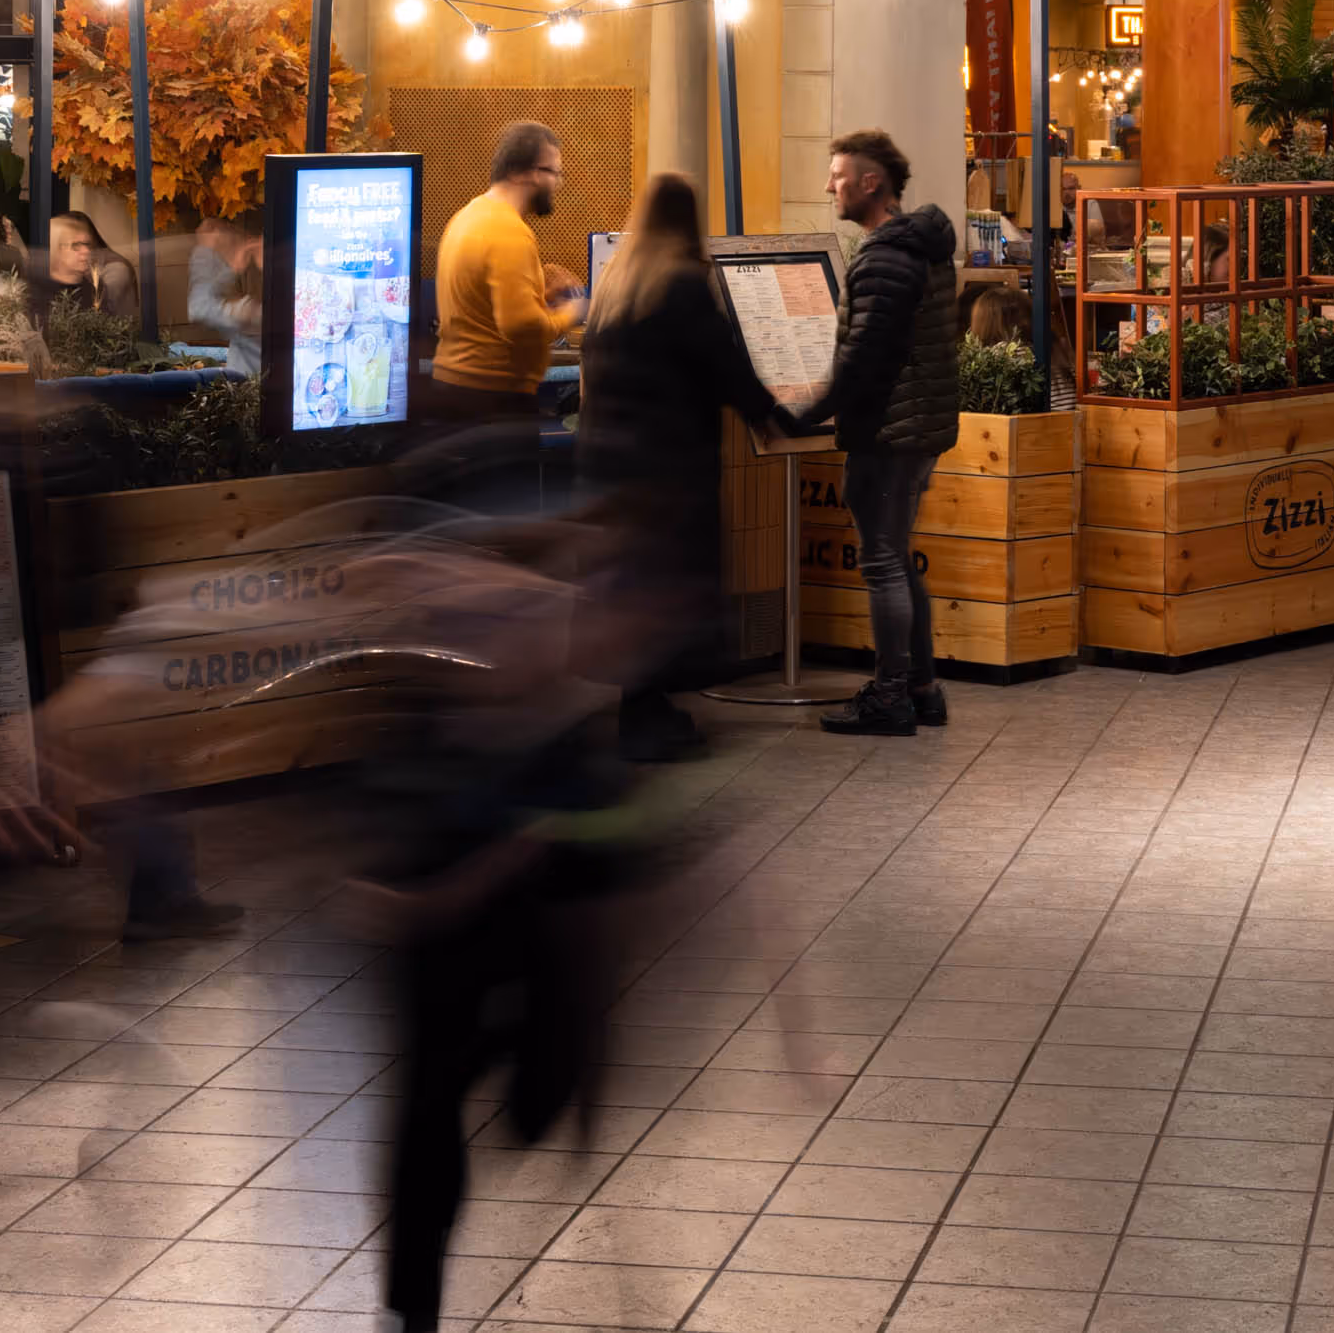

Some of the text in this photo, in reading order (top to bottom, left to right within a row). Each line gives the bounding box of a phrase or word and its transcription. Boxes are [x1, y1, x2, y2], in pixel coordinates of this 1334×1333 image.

[985, 10, 1000, 80] THAI
[1122, 16, 1144, 34] TH
[1262, 490, 1326, 536] Zizzi
[190, 564, 345, 612] CHORIZO
